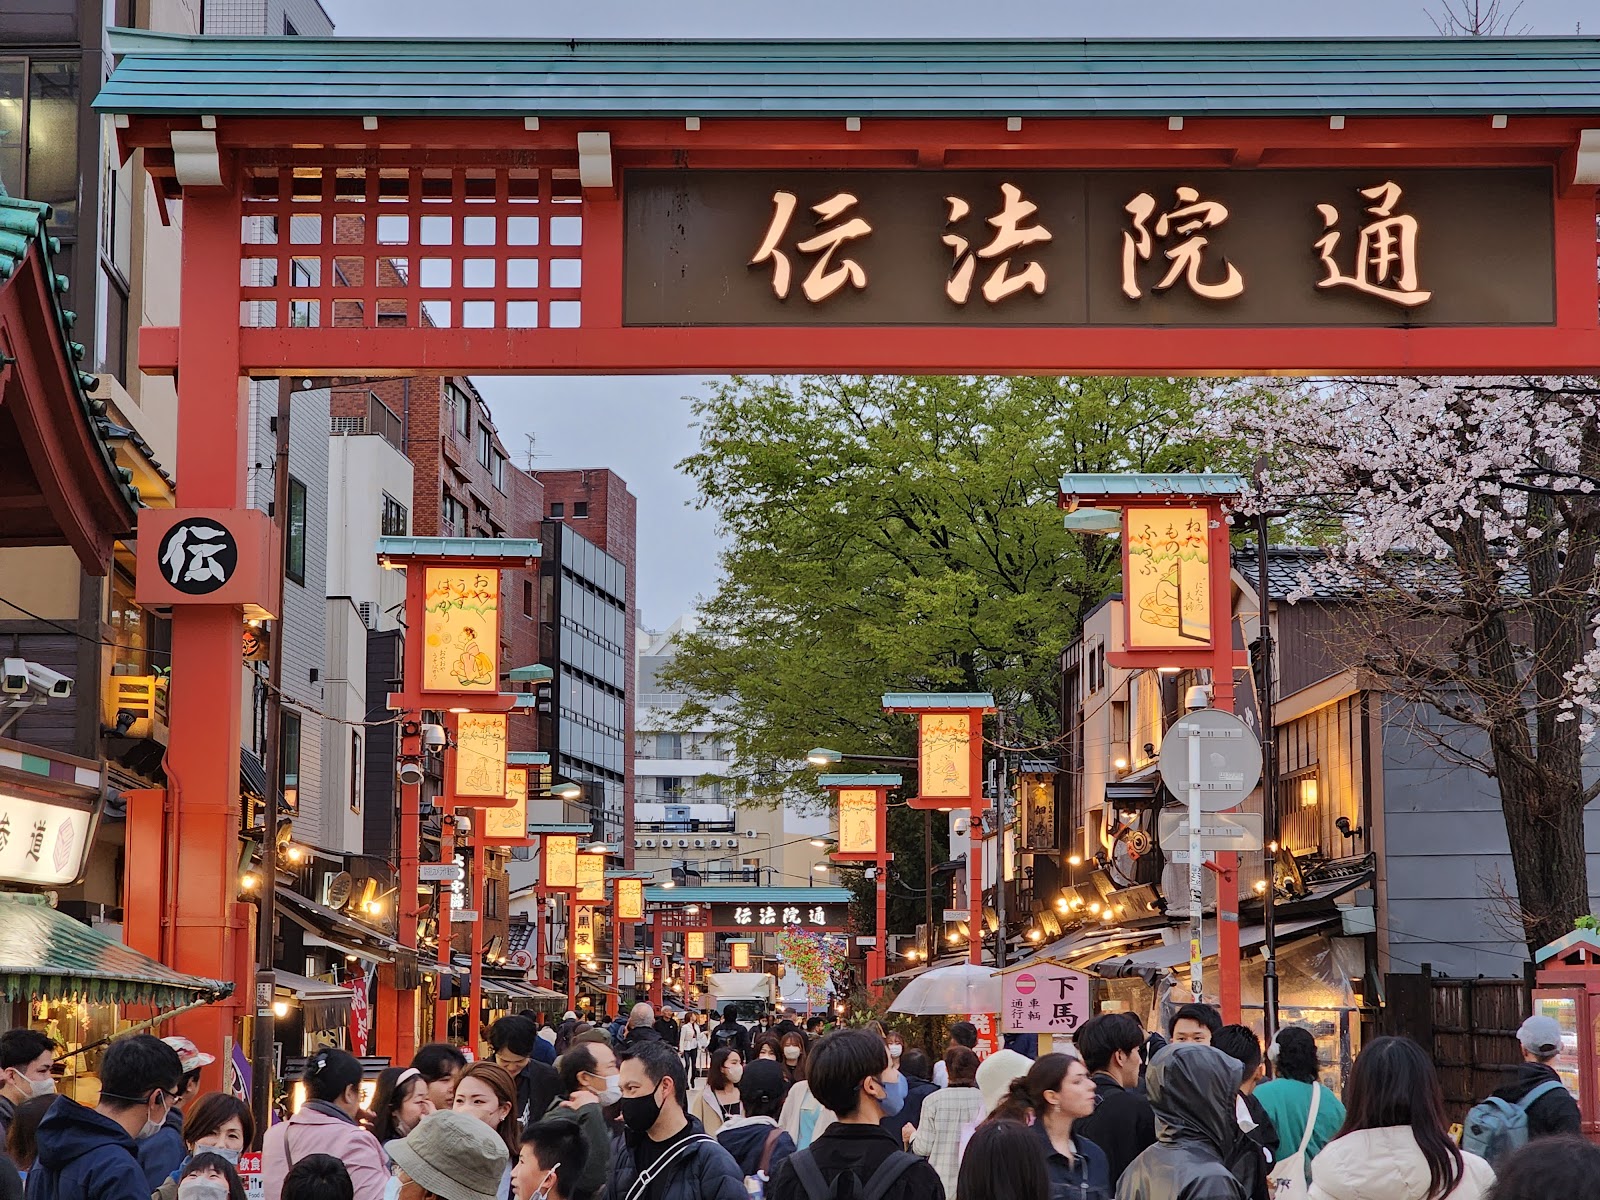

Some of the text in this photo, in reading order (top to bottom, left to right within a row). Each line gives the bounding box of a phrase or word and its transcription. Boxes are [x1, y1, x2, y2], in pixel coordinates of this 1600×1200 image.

[752, 182, 1432, 307] 伝法院通
[1165, 523, 1180, 555] もの
[1185, 517, 1202, 549] ねた
[161, 525, 227, 584] 伝
[1138, 524, 1158, 576] ふうふ
[734, 906, 827, 926] 伝法院通
[1011, 998, 1024, 1029] 通行止
[1028, 998, 1041, 1021] 車輌
[1048, 976, 1079, 1029] 下馬
[239, 1157, 261, 1171] 飲食
